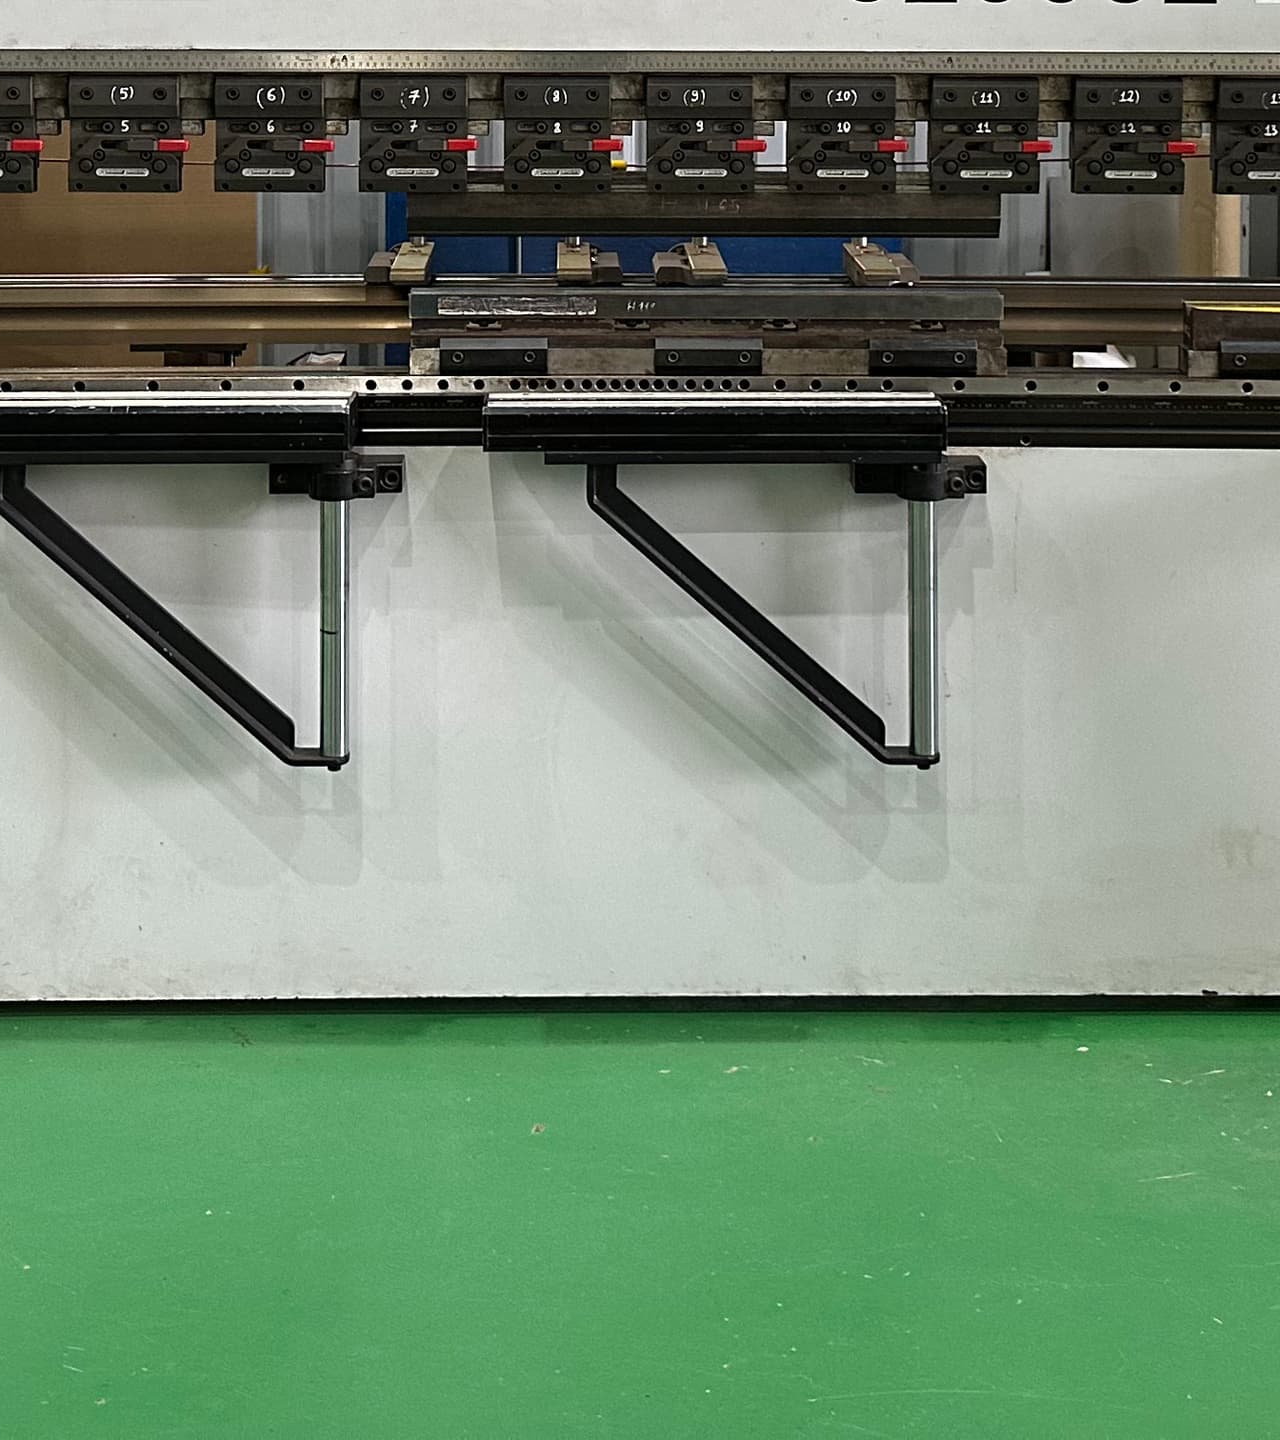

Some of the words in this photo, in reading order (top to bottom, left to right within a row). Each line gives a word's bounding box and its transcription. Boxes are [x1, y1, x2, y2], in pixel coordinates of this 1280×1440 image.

[120, 120, 130, 133] 5
[265, 120, 275, 133] 6
[408, 120, 419, 133] 7
[696, 120, 704, 133] 9
[836, 121, 852, 134] 10
[975, 122, 992, 134] 11
[1120, 122, 1136, 134] 12
[1263, 124, 1279, 137] 13
